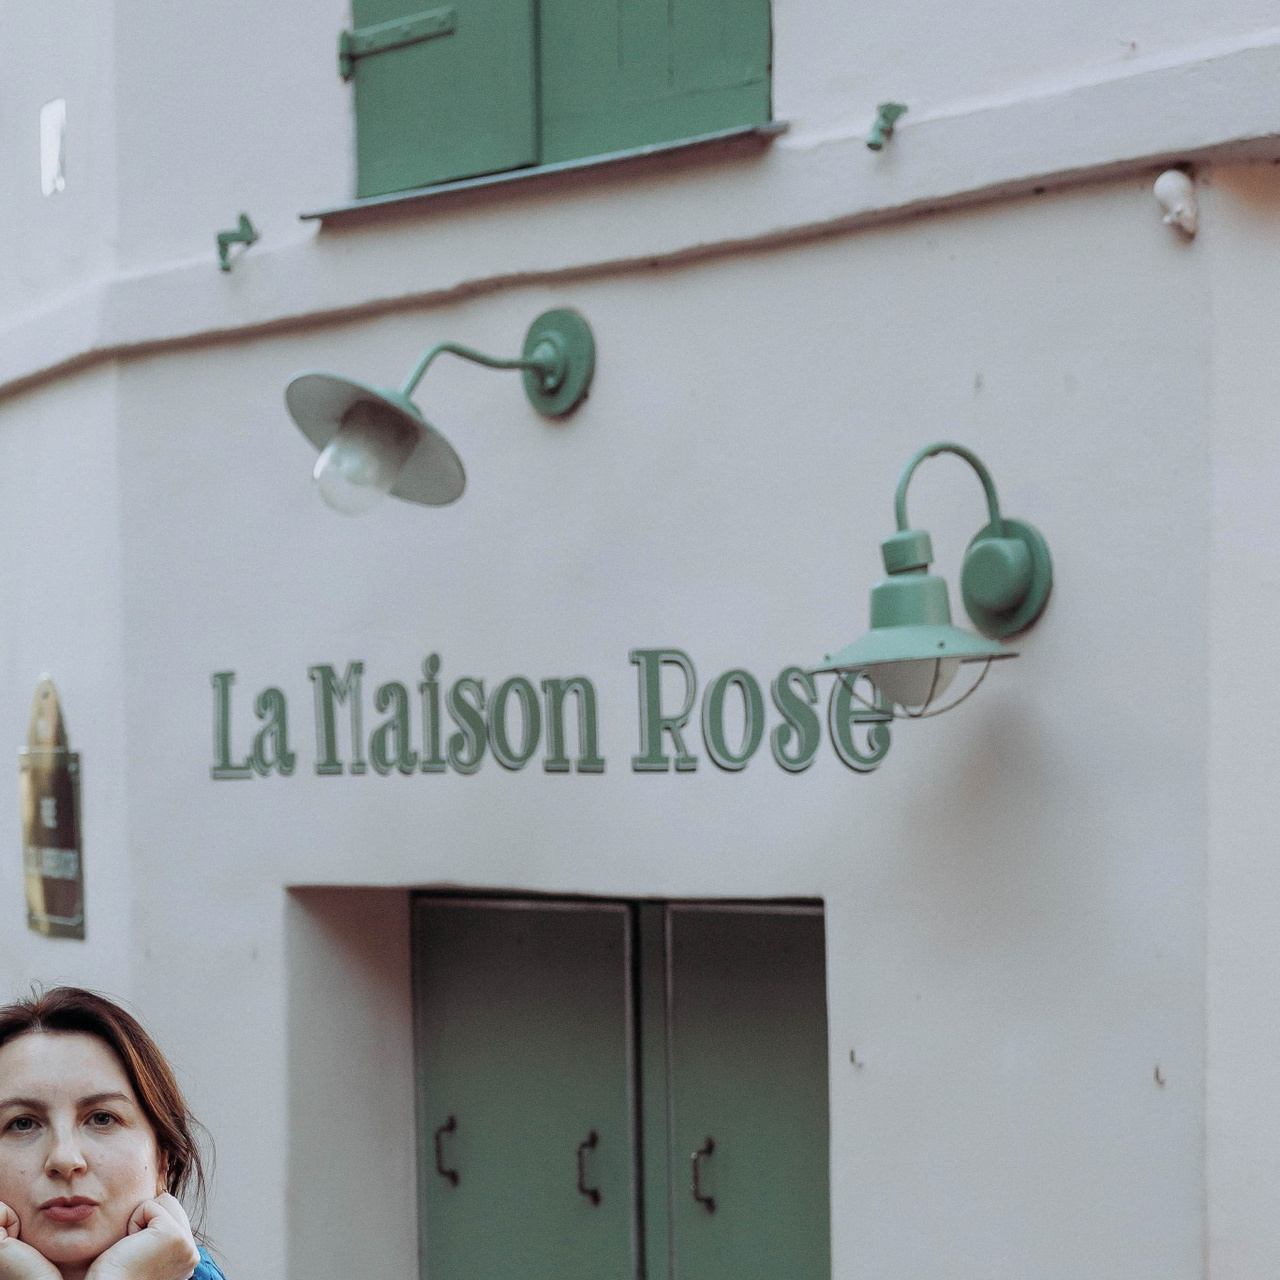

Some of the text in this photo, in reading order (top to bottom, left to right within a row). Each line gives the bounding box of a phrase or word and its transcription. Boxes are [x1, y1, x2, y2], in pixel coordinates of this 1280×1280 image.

[211, 648, 892, 780] La Maison Rose
